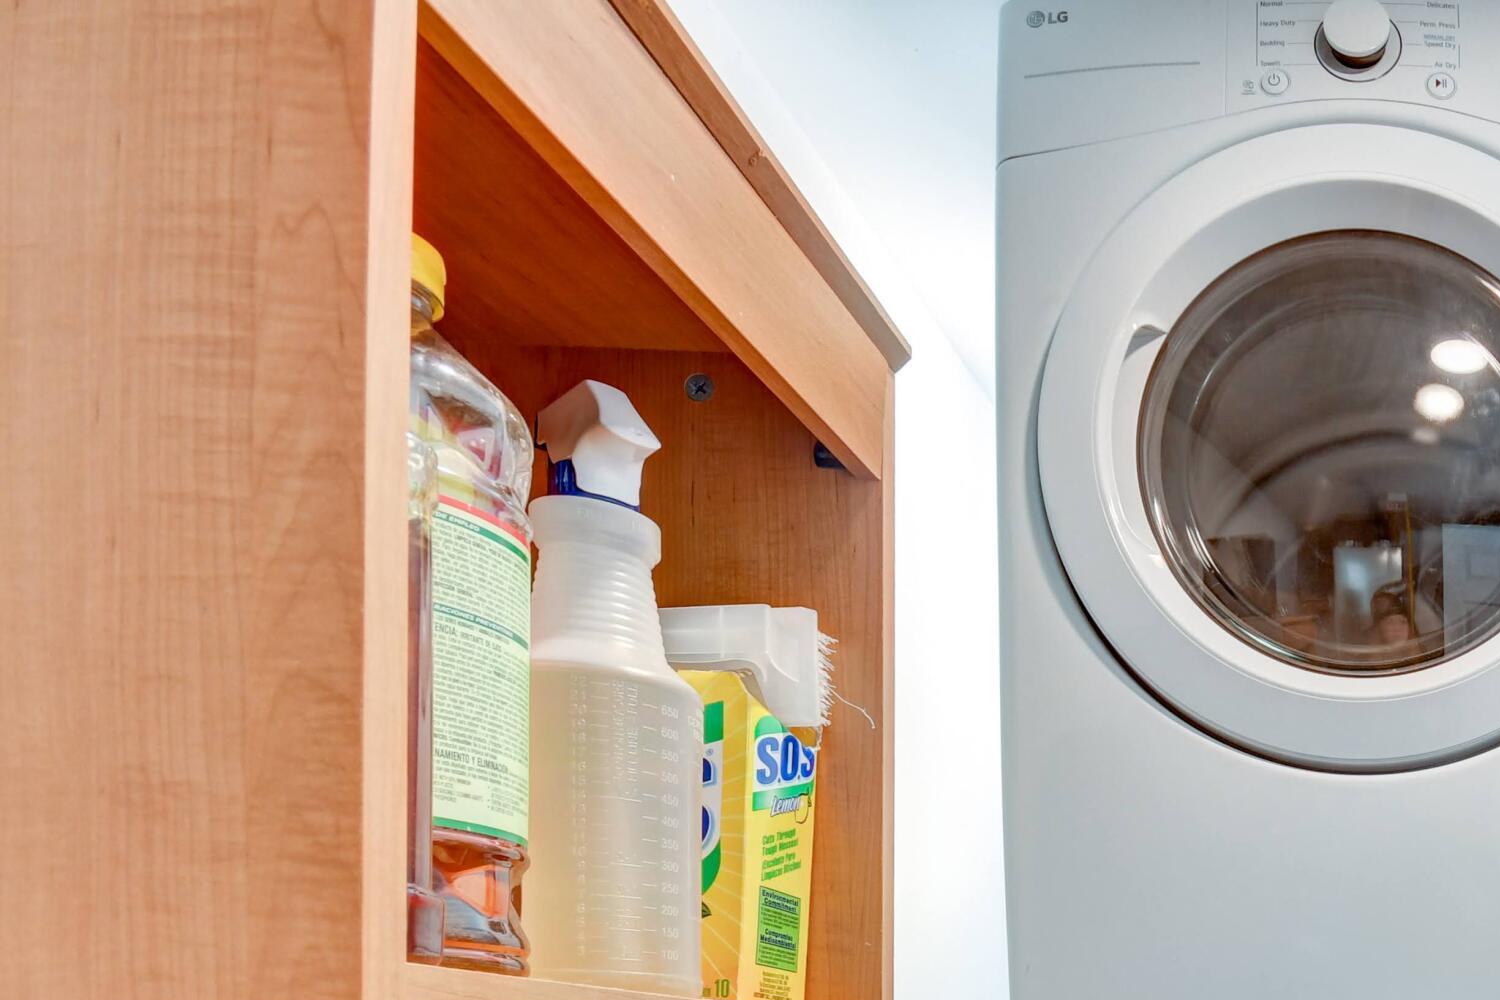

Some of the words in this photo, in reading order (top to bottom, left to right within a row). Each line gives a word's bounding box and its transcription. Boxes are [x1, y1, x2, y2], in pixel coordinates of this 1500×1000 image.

[1260, 20, 1279, 28] Heavy
[1280, 19, 1296, 27] Duty
[1259, 40, 1285, 48] Bedding
[661, 706, 680, 719] 650
[661, 728, 680, 741] 600
[661, 750, 680, 763] 550
[661, 772, 680, 785] 500
[661, 794, 680, 807] 450
[770, 795, 801, 818] Lemon
[661, 816, 680, 829] 400
[661, 838, 680, 851] 350
[762, 845, 778, 857] Tough
[661, 861, 680, 873] 300
[661, 883, 680, 895] 250
[661, 904, 680, 917] 200
[764, 897, 798, 914] Commitment
[662, 927, 680, 939] 150
[662, 949, 680, 961] 100
[714, 978, 730, 999] 10
